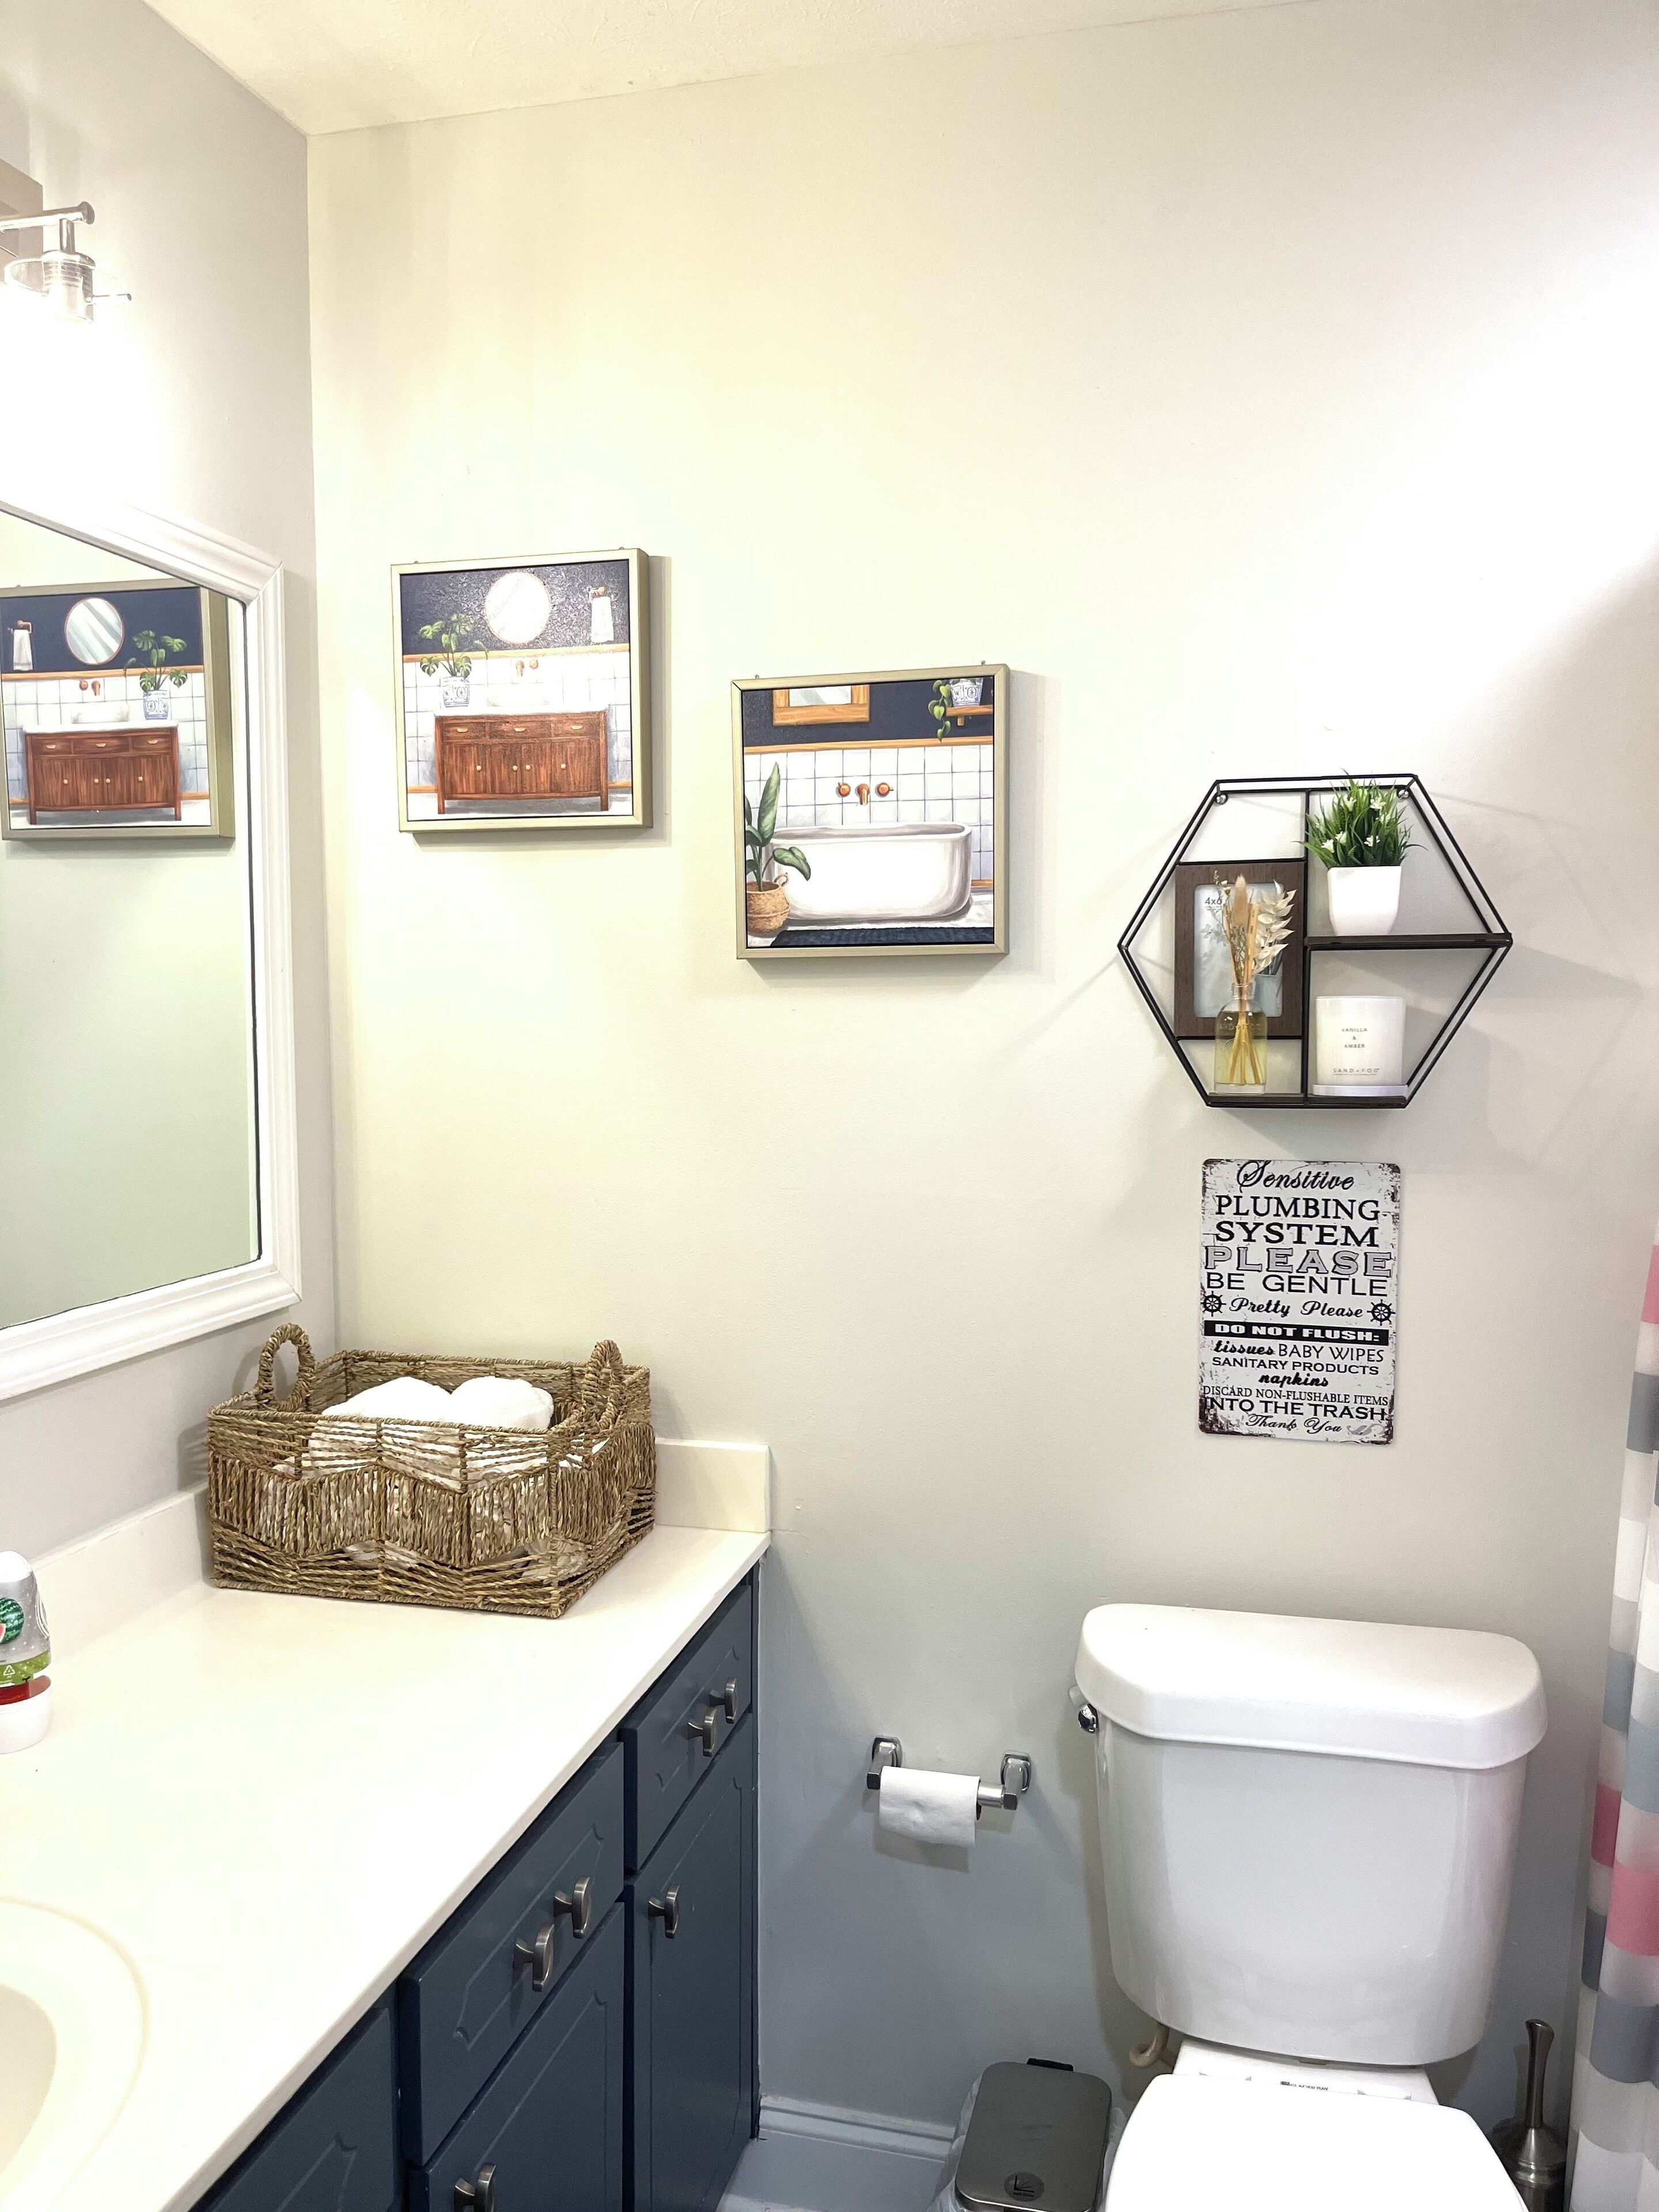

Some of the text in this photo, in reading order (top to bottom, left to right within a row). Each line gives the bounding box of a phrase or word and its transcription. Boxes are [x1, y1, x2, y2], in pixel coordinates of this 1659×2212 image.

[1237, 1160, 1354, 1193] Sensitive
[1215, 1195, 1380, 1221] PLUMBING
[1215, 1221, 1380, 1247] SYSTEM
[1205, 1246, 1392, 1277] PLEASE
[1206, 1272, 1388, 1296] BE GENTLE
[1229, 1297, 1363, 1317] Pretty Please
[1214, 1324, 1380, 1342] DO NOT FLUSH:
[1213, 1340, 1384, 1362] tissues BABY WIPES
[1212, 1357, 1380, 1375] SANITARY PRODUCTS
[1258, 1372, 1329, 1388] napkins
[1203, 1385, 1389, 1406] DISCARD NON-FLUSHABLE ITEMS
[1203, 1397, 1255, 1412] INTO
[1259, 1400, 1304, 1415] THE
[1245, 1413, 1342, 1434] Thank You
